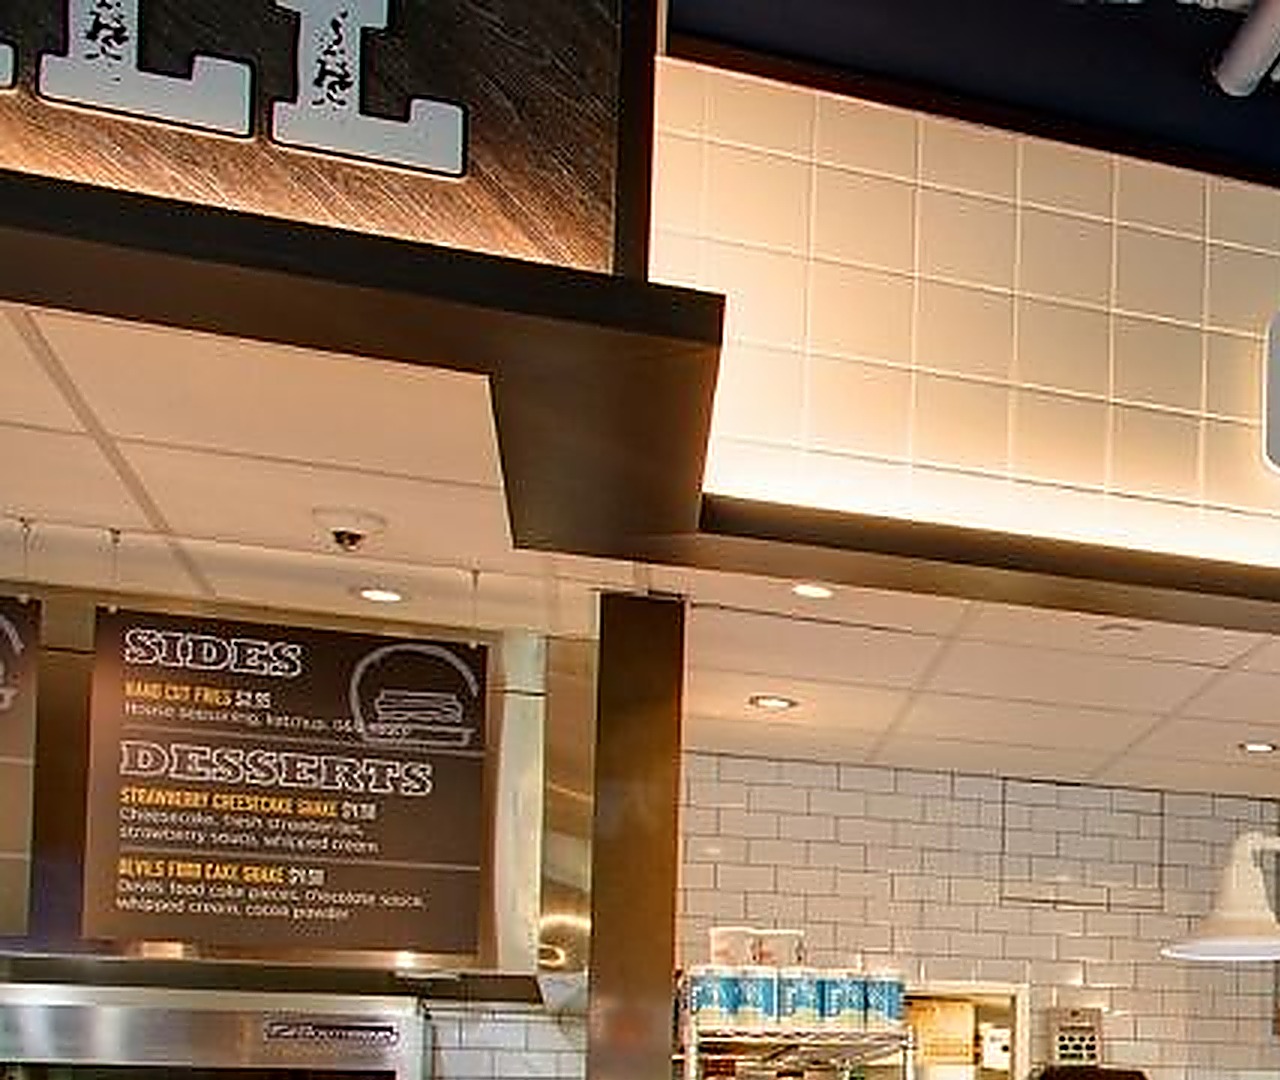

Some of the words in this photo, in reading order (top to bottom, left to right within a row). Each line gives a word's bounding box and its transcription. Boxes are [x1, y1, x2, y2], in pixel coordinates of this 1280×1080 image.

[0, 0, 466, 178] LL
[125, 629, 301, 677] SIDES
[120, 740, 433, 796] DESSERTS
